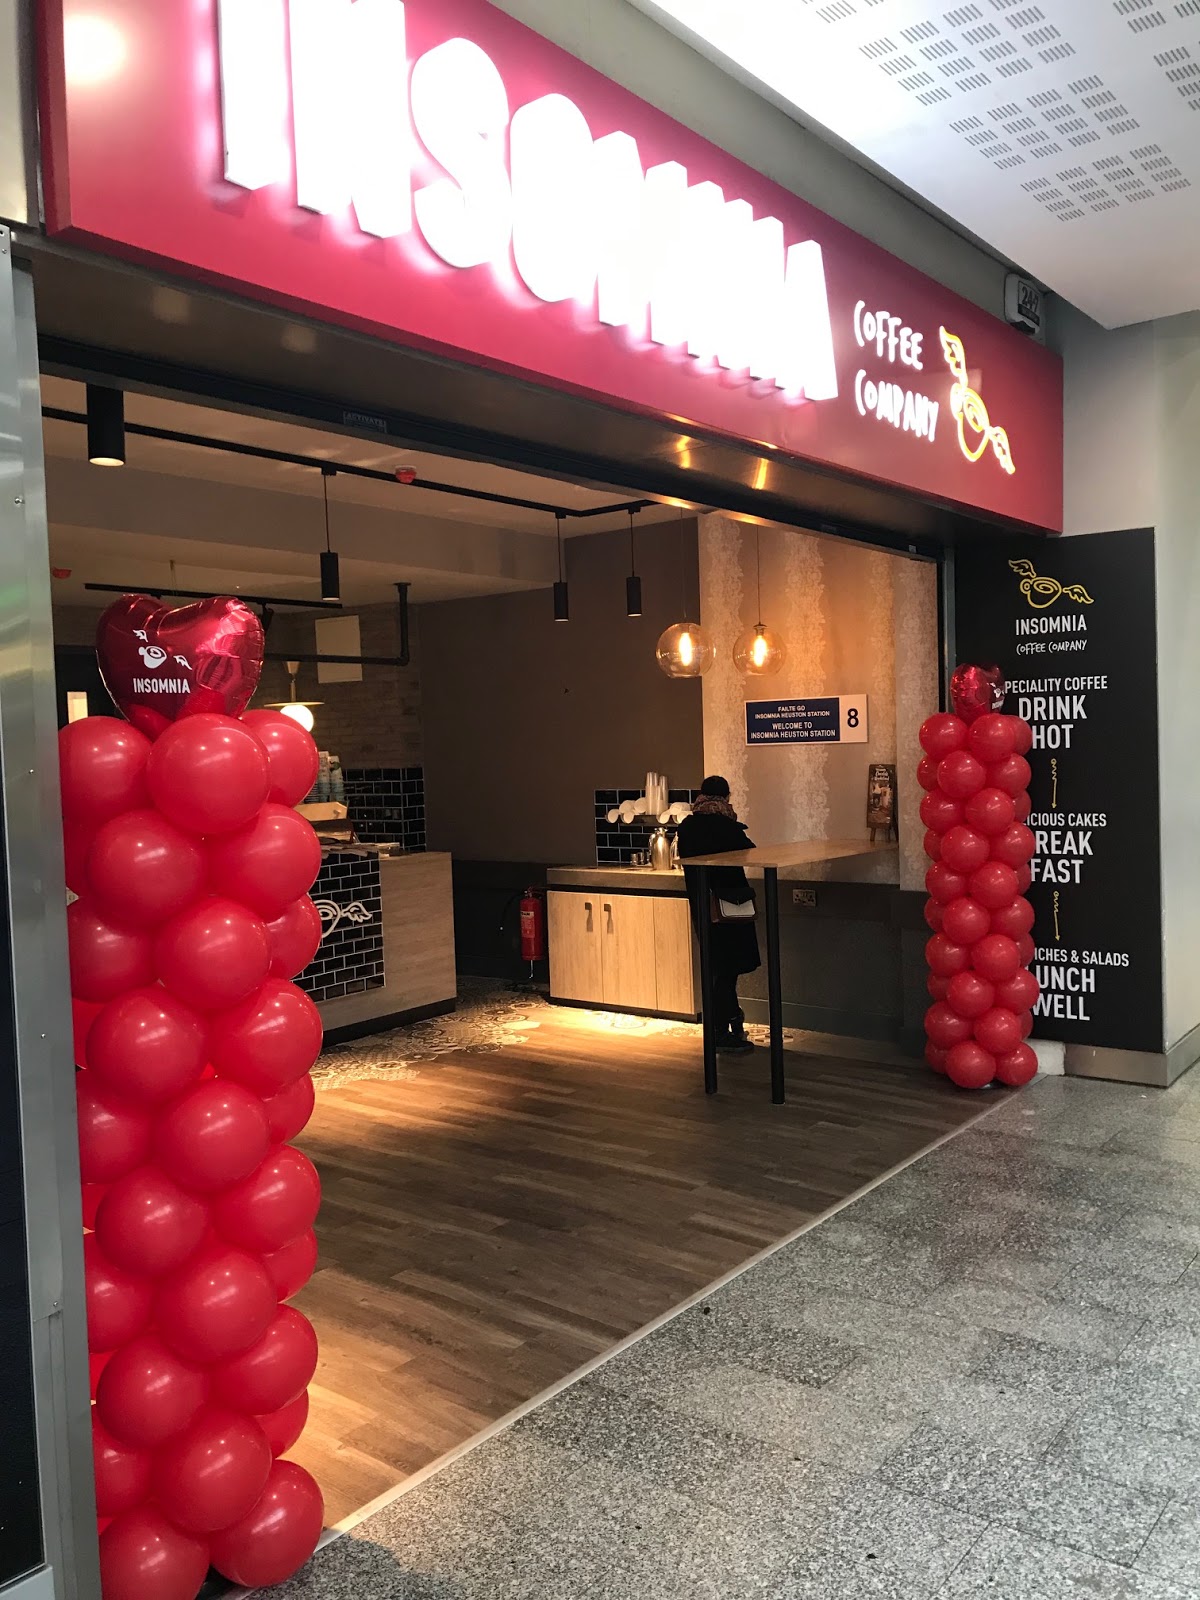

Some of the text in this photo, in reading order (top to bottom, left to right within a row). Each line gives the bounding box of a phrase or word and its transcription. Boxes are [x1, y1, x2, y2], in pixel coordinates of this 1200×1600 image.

[853, 299, 924, 371] COFFEE
[854, 368, 940, 443] COMPANY
[1015, 614, 1088, 636] INSOMNIA
[1016, 639, 1088, 655] COFFEE COMPANY
[132, 677, 191, 694] INSOMNIA
[1004, 675, 1108, 694] PECIALITY COFFEE
[754, 710, 830, 720] INSOMNIA HEUSTON STATION
[797, 704, 806, 712] GO
[847, 707, 859, 729] 8
[1018, 694, 1088, 721] DRINK
[750, 729, 836, 739] INSOMNIA HEUSTON STATION
[772, 721, 813, 730] WELCOME TO
[1023, 812, 1107, 827] ICIOUS CAKES
[1035, 830, 1094, 856] REAK
[1030, 858, 1084, 884] FAST
[1034, 947, 1130, 967] ICHES & SALADS
[1025, 964, 1096, 993] UNCH
[1032, 992, 1091, 1021] WELL
